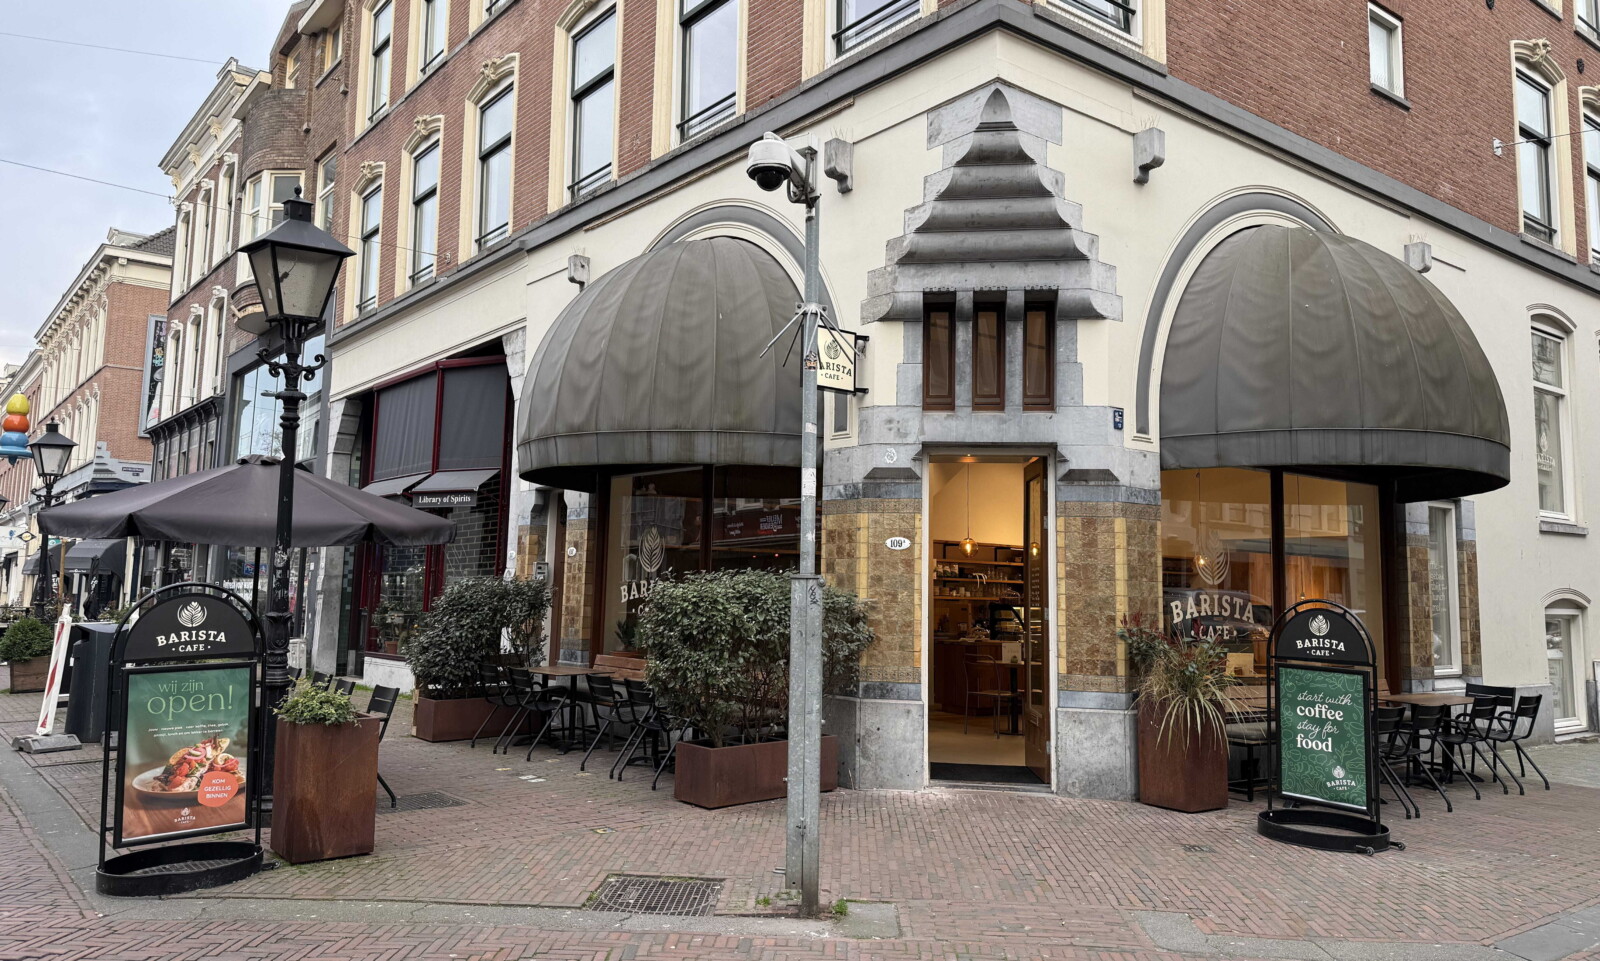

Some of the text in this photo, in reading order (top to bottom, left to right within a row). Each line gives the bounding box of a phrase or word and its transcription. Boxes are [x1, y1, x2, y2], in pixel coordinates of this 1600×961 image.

[824, 372, 840, 380] CAFE
[418, 494, 471, 505] Library of Spirits
[1170, 594, 1255, 624] BARISTA
[156, 630, 227, 647] BARISTA
[1199, 625, 1231, 640] CAFE
[178, 643, 205, 652] CAFE
[1295, 638, 1346, 652] BARISTA
[158, 679, 204, 694] wij zijn
[147, 684, 233, 721] open!
[1297, 690, 1353, 705] start with
[1296, 703, 1344, 721] coffee
[1297, 719, 1340, 740] stay for
[1296, 733, 1333, 753] food
[1326, 779, 1356, 788] BARISTA
[174, 815, 196, 823] BARISTA
